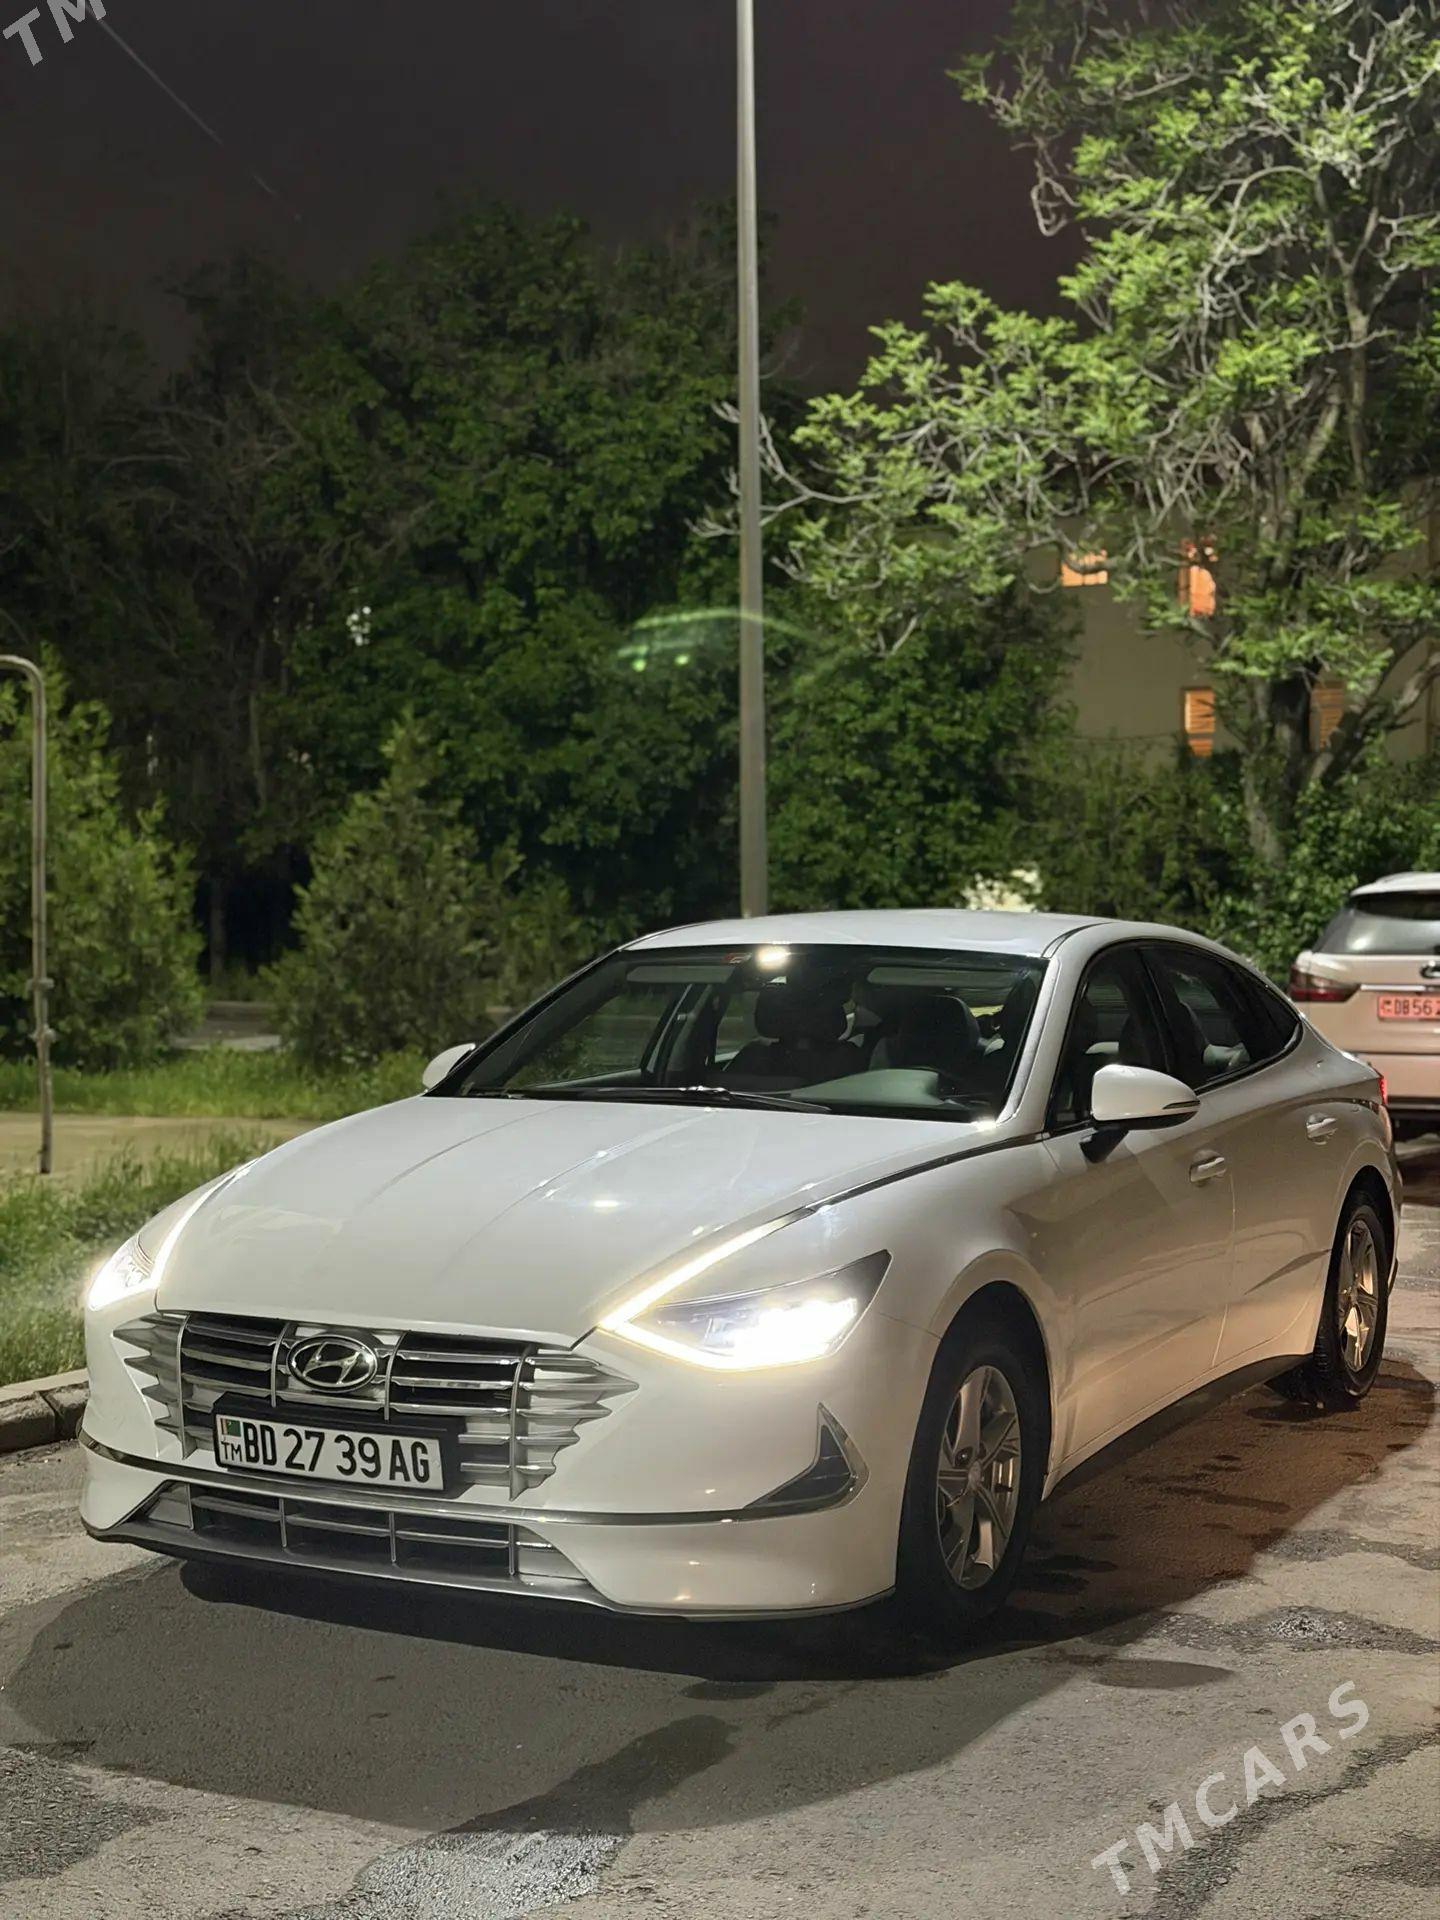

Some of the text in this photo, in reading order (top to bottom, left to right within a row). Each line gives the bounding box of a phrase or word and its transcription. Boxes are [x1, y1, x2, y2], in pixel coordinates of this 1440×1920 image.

[1412, 999, 1432, 1015] 56
[221, 1440, 242, 1462] TM
[243, 1421, 430, 1483] BD 27 39 AG
